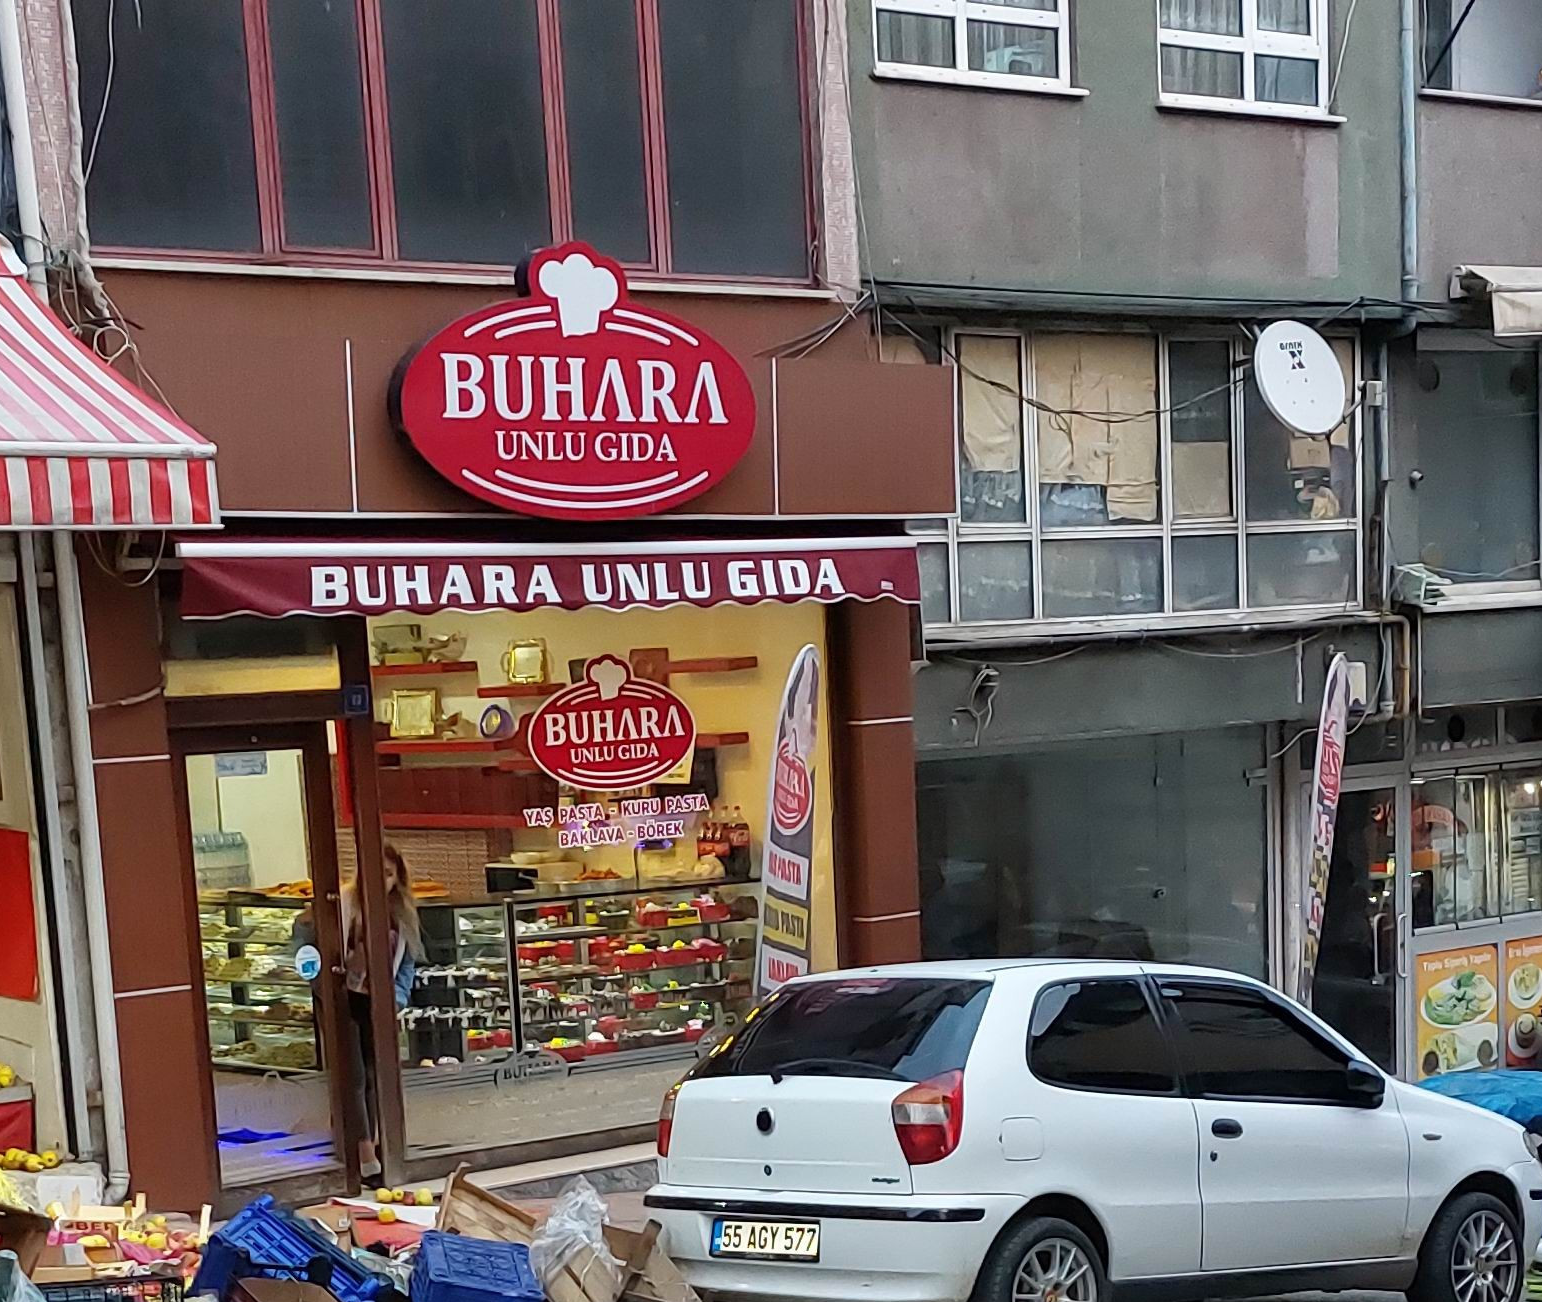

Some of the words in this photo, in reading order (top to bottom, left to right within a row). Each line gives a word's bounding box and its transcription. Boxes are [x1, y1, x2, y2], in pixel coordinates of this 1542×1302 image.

[440, 353, 730, 424] BUHARA
[495, 430, 587, 462] UNLU
[594, 431, 678, 462] GIDA
[311, 562, 561, 608] BUHARA
[580, 560, 712, 603] UNLU
[728, 557, 846, 599] GIDA
[544, 705, 685, 747] BUHARA
[570, 746, 615, 764] UNLU
[618, 743, 659, 761] GIDA
[523, 807, 554, 828] YAŞ
[558, 803, 604, 825] PASTA
[621, 797, 660, 816] KURU
[665, 793, 711, 814] PASTA
[558, 827, 625, 848] BAKLAVA
[637, 820, 684, 840] BÖREK
[722, 1224, 743, 1248] 55
[747, 1225, 780, 1250] AGY
[784, 1227, 817, 1252] 577
